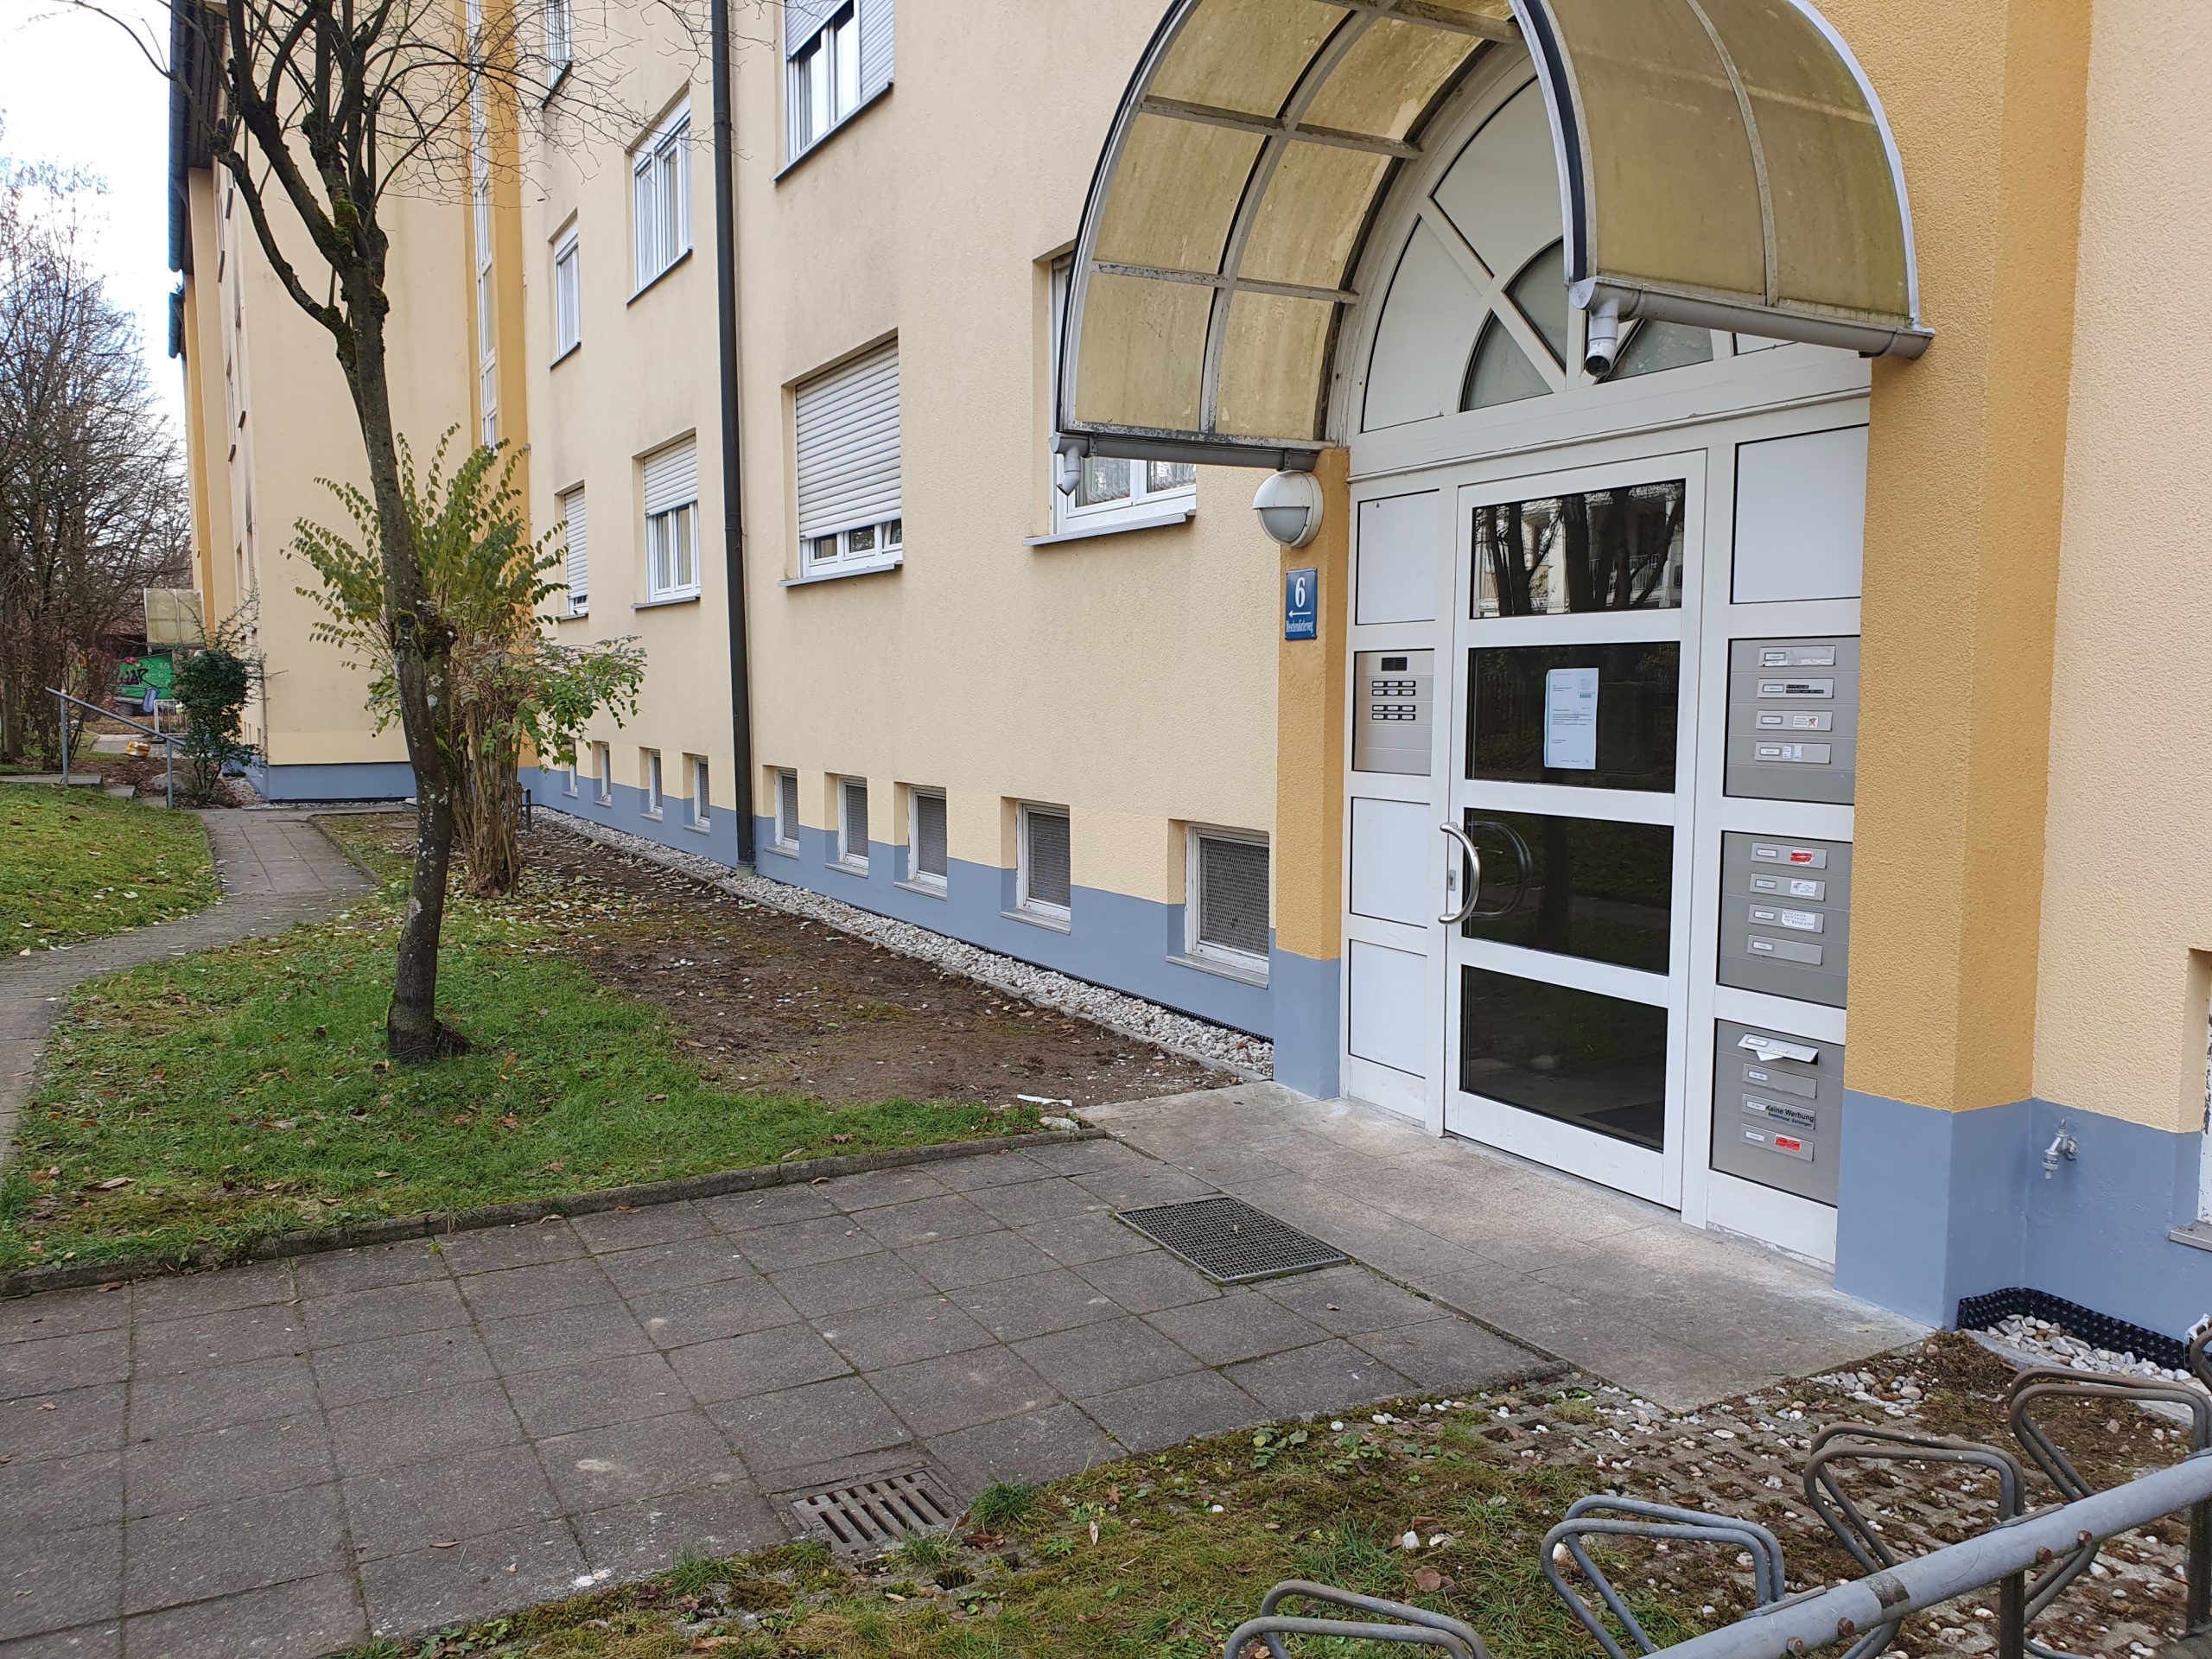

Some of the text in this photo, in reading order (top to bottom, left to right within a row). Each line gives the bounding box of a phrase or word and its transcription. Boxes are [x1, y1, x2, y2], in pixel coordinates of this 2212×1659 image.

[1295, 576, 1306, 608] 6
[1765, 1104, 1815, 1123] Keine Werbung
